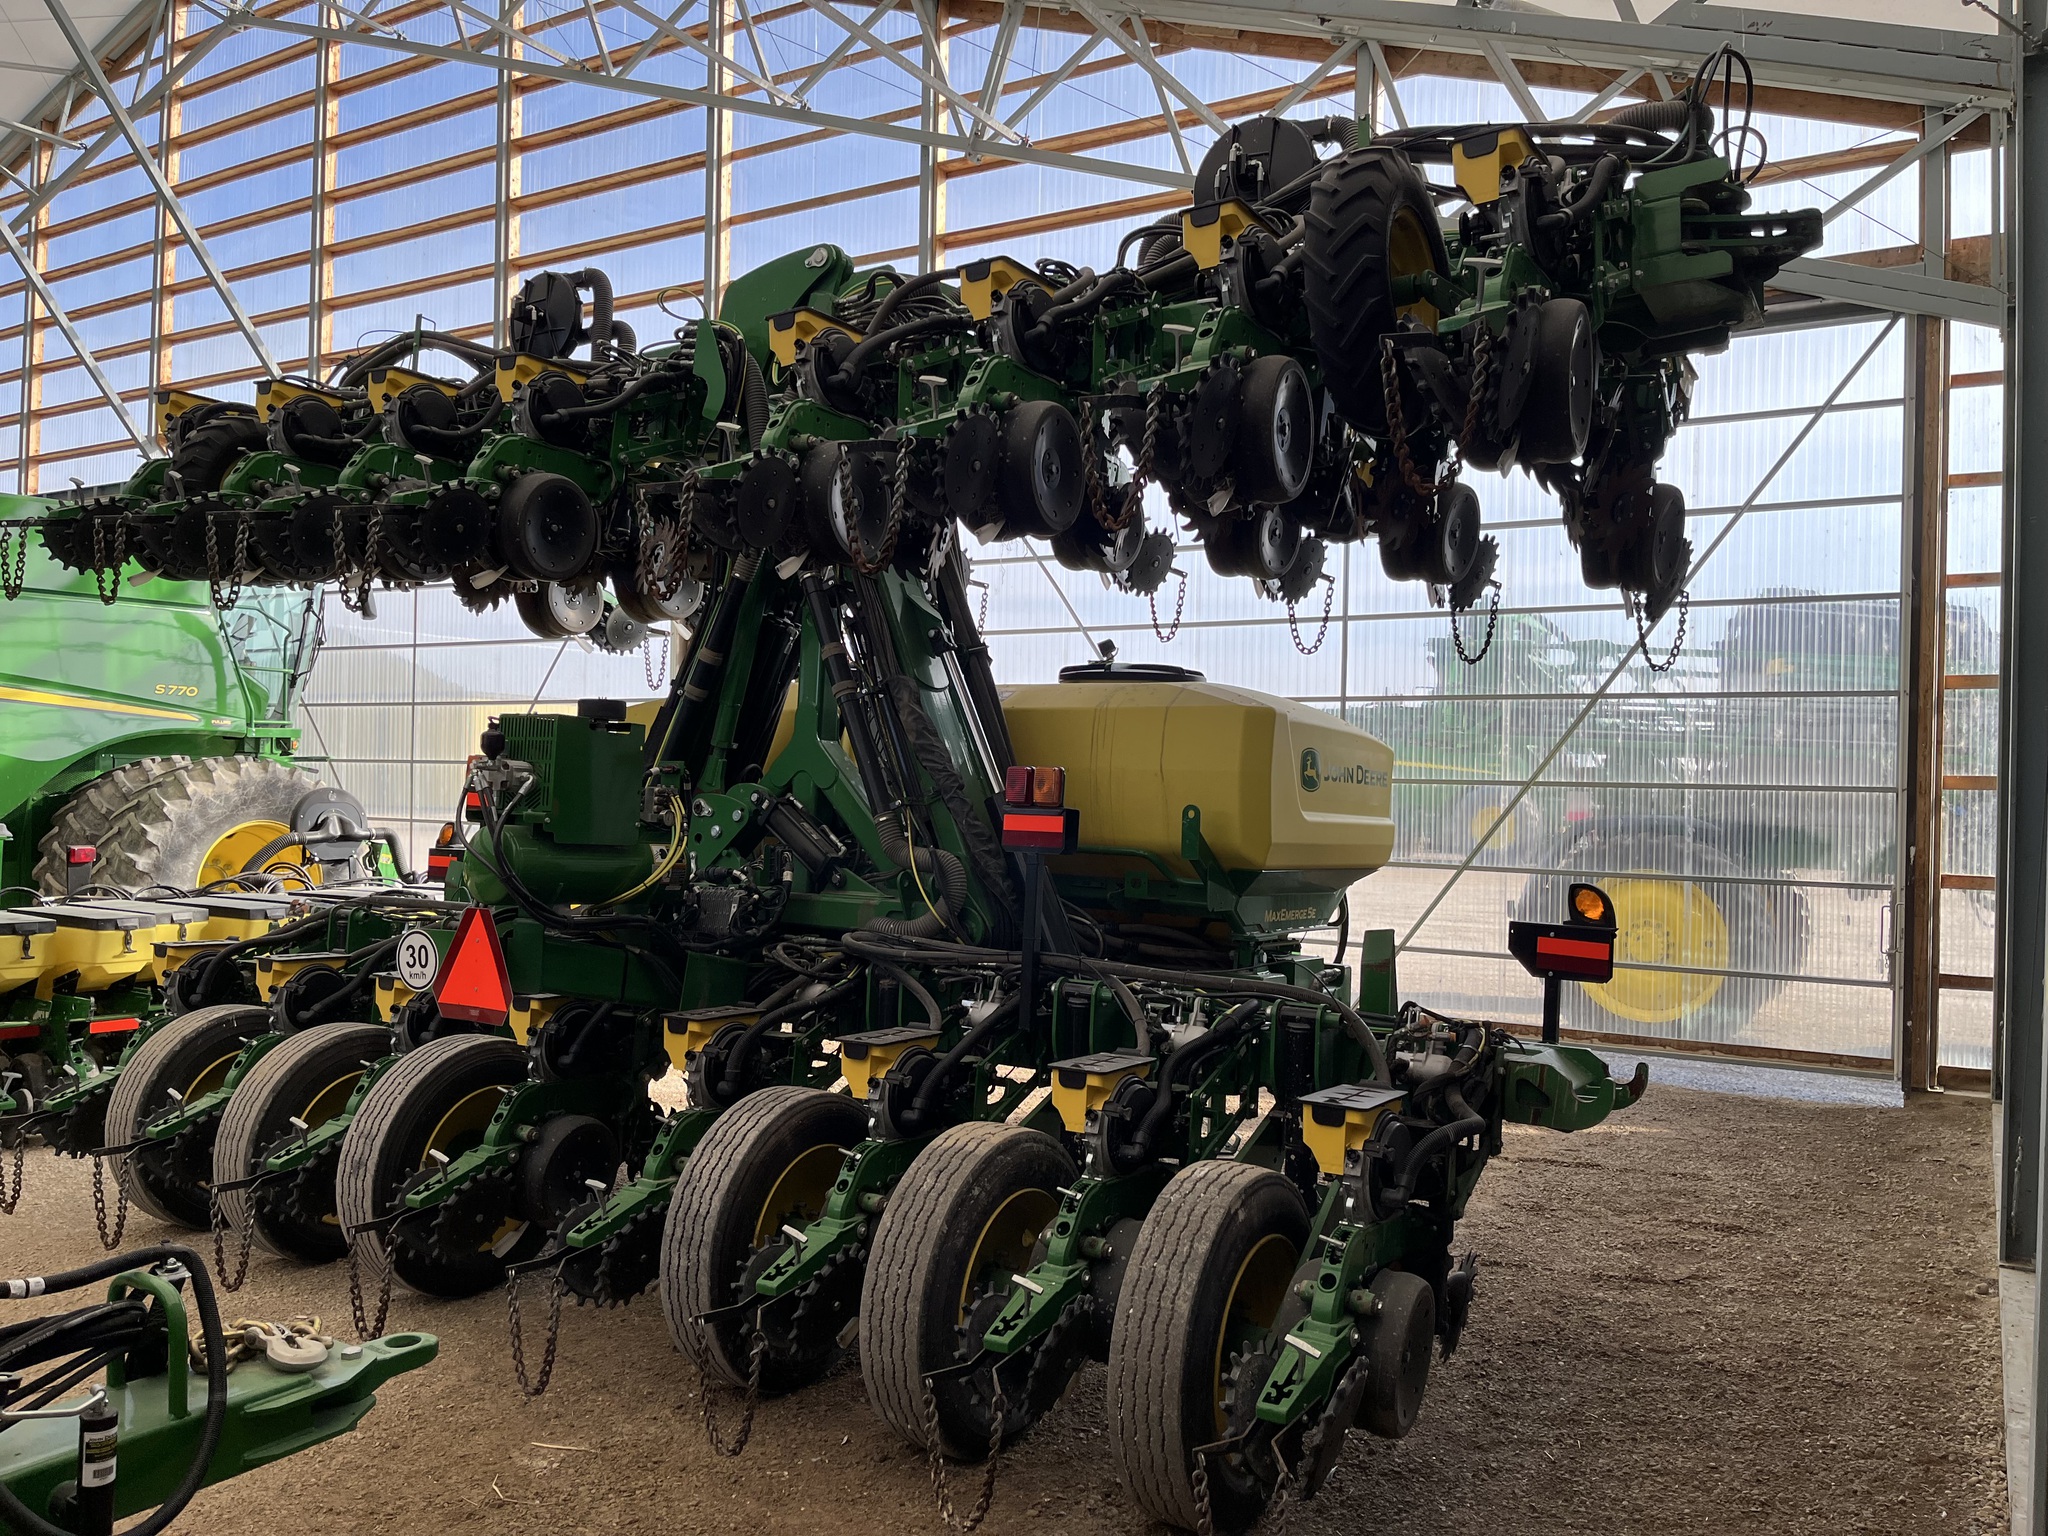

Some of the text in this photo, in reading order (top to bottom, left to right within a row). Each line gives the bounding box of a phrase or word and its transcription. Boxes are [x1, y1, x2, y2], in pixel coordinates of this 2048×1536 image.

[1324, 765, 1389, 788] JOHN DEERE
[405, 944, 428, 968] 30
[409, 971, 427, 980] km/h
